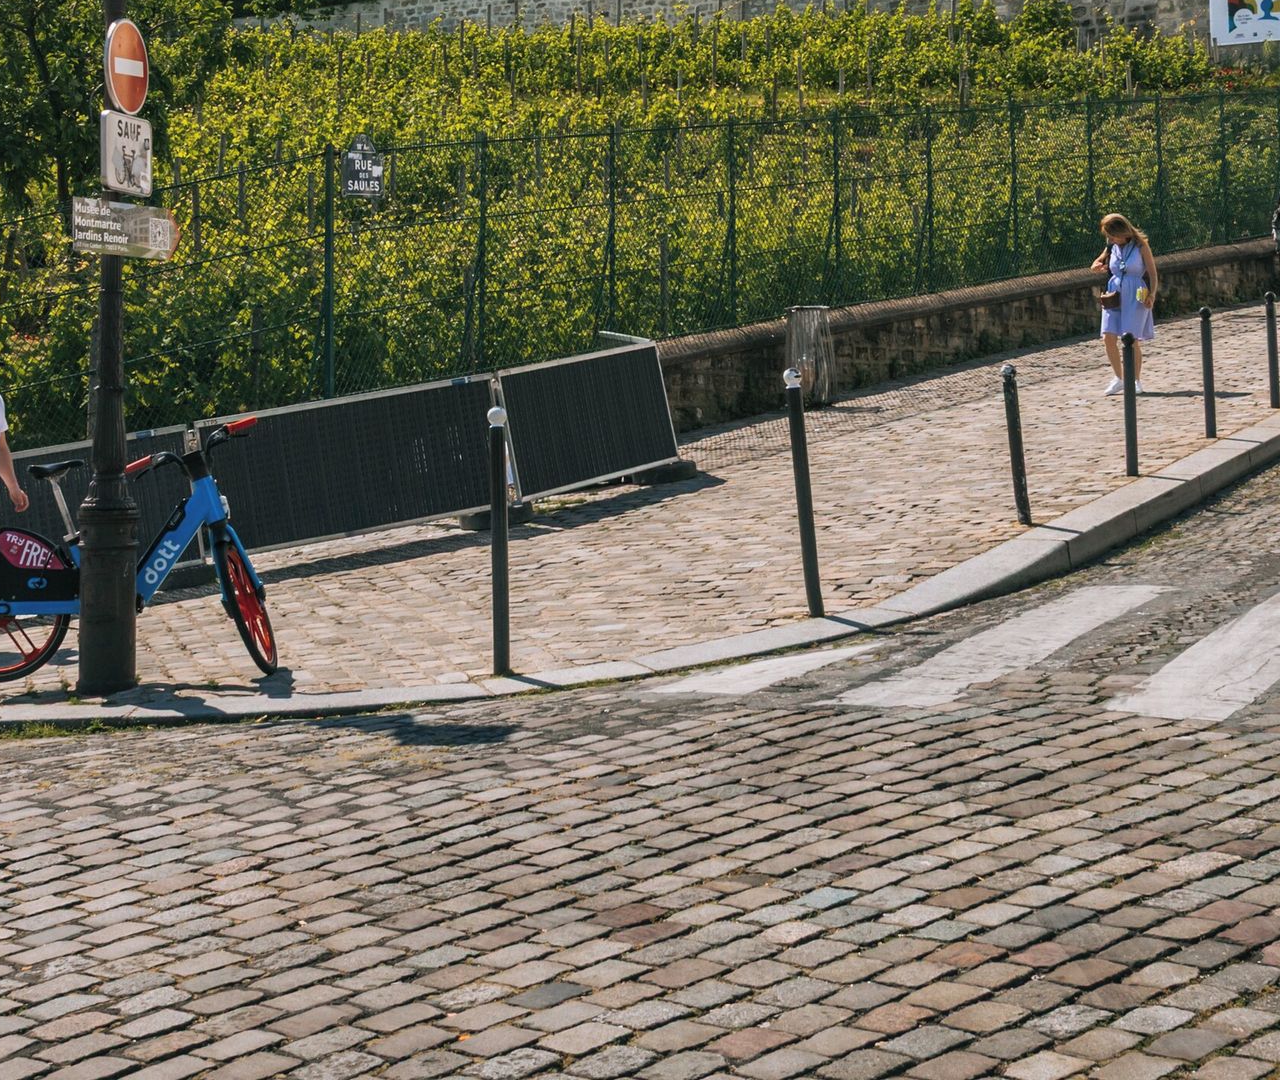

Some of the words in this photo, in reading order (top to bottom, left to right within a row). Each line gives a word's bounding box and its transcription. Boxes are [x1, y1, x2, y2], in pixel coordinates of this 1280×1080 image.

[117, 119, 141, 141] SAUF
[355, 160, 372, 171] RUE
[347, 180, 380, 192] SAULES
[100, 204, 111, 216] de
[74, 215, 122, 231] Montmartre
[74, 229, 102, 242] Jardins
[103, 232, 129, 244] Renoir
[145, 539, 180, 585] dott
